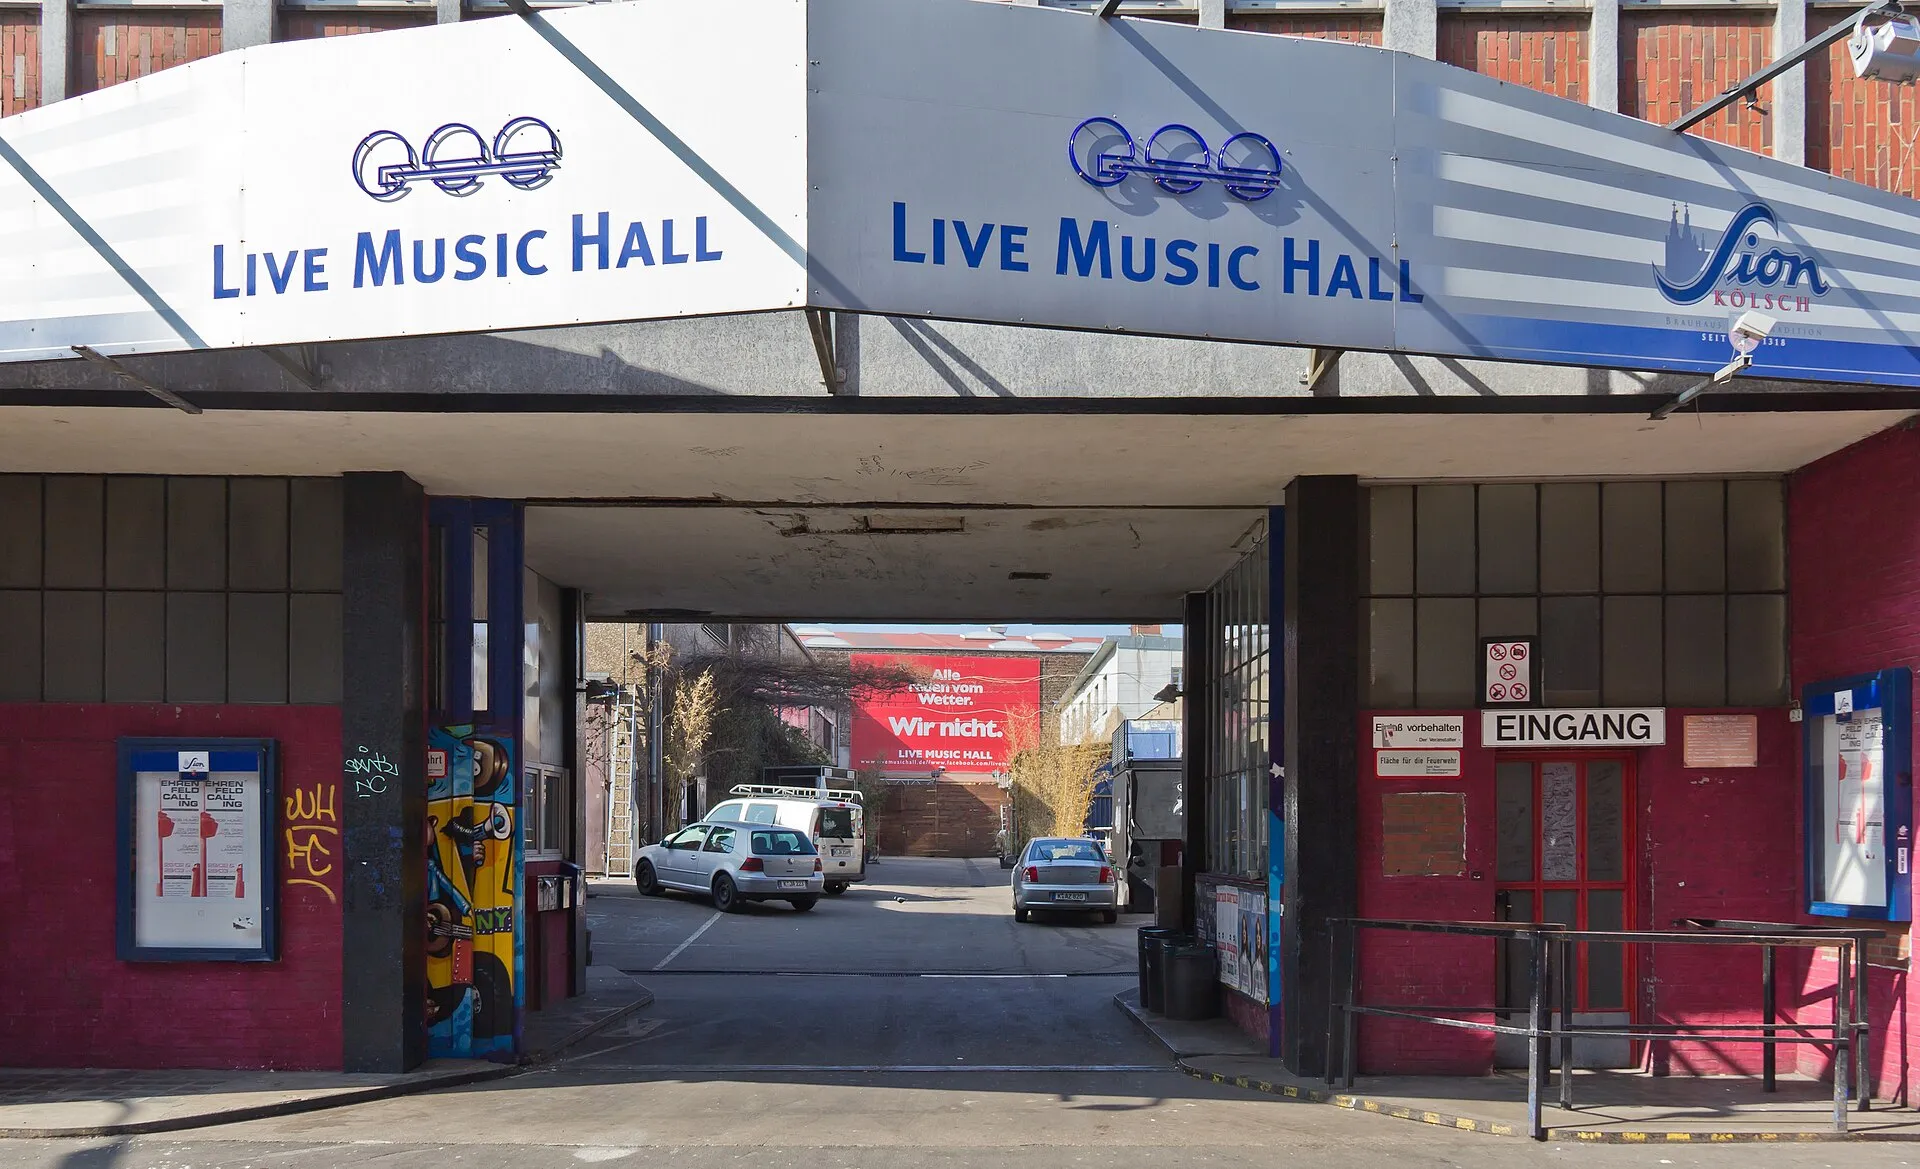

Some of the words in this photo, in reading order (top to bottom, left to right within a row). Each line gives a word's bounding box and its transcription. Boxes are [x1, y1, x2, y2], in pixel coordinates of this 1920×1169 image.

[213, 244, 329, 299] LIVE
[353, 229, 548, 288] MUSIC
[572, 211, 724, 272] HALL
[892, 201, 1029, 272] LIVE
[1056, 217, 1260, 291] MUSIC
[1284, 237, 1424, 304] HALL
[1652, 202, 1831, 305] Sion
[1714, 289, 1811, 313] KÖLSCH
[1701, 333, 1727, 343] SEIT
[1762, 338, 1786, 347] 1318
[932, 669, 960, 681] Alle
[952, 684, 983, 694] vom
[918, 693, 974, 706] Wetter.
[888, 717, 935, 737] Wir
[940, 718, 1003, 738] nicht.
[1407, 723, 1461, 732] vorbehalten
[1496, 713, 1651, 741] EINGANG
[898, 750, 922, 758] LIVE
[925, 750, 963, 759] MUSIC
[963, 751, 993, 760] HALL
[1380, 756, 1400, 765] Fläche
[1402, 756, 1412, 765] für
[1414, 756, 1424, 765] die
[1426, 756, 1457, 765] Feuerwehr
[183, 757, 205, 769] Sion
[476, 910, 510, 931] NY
